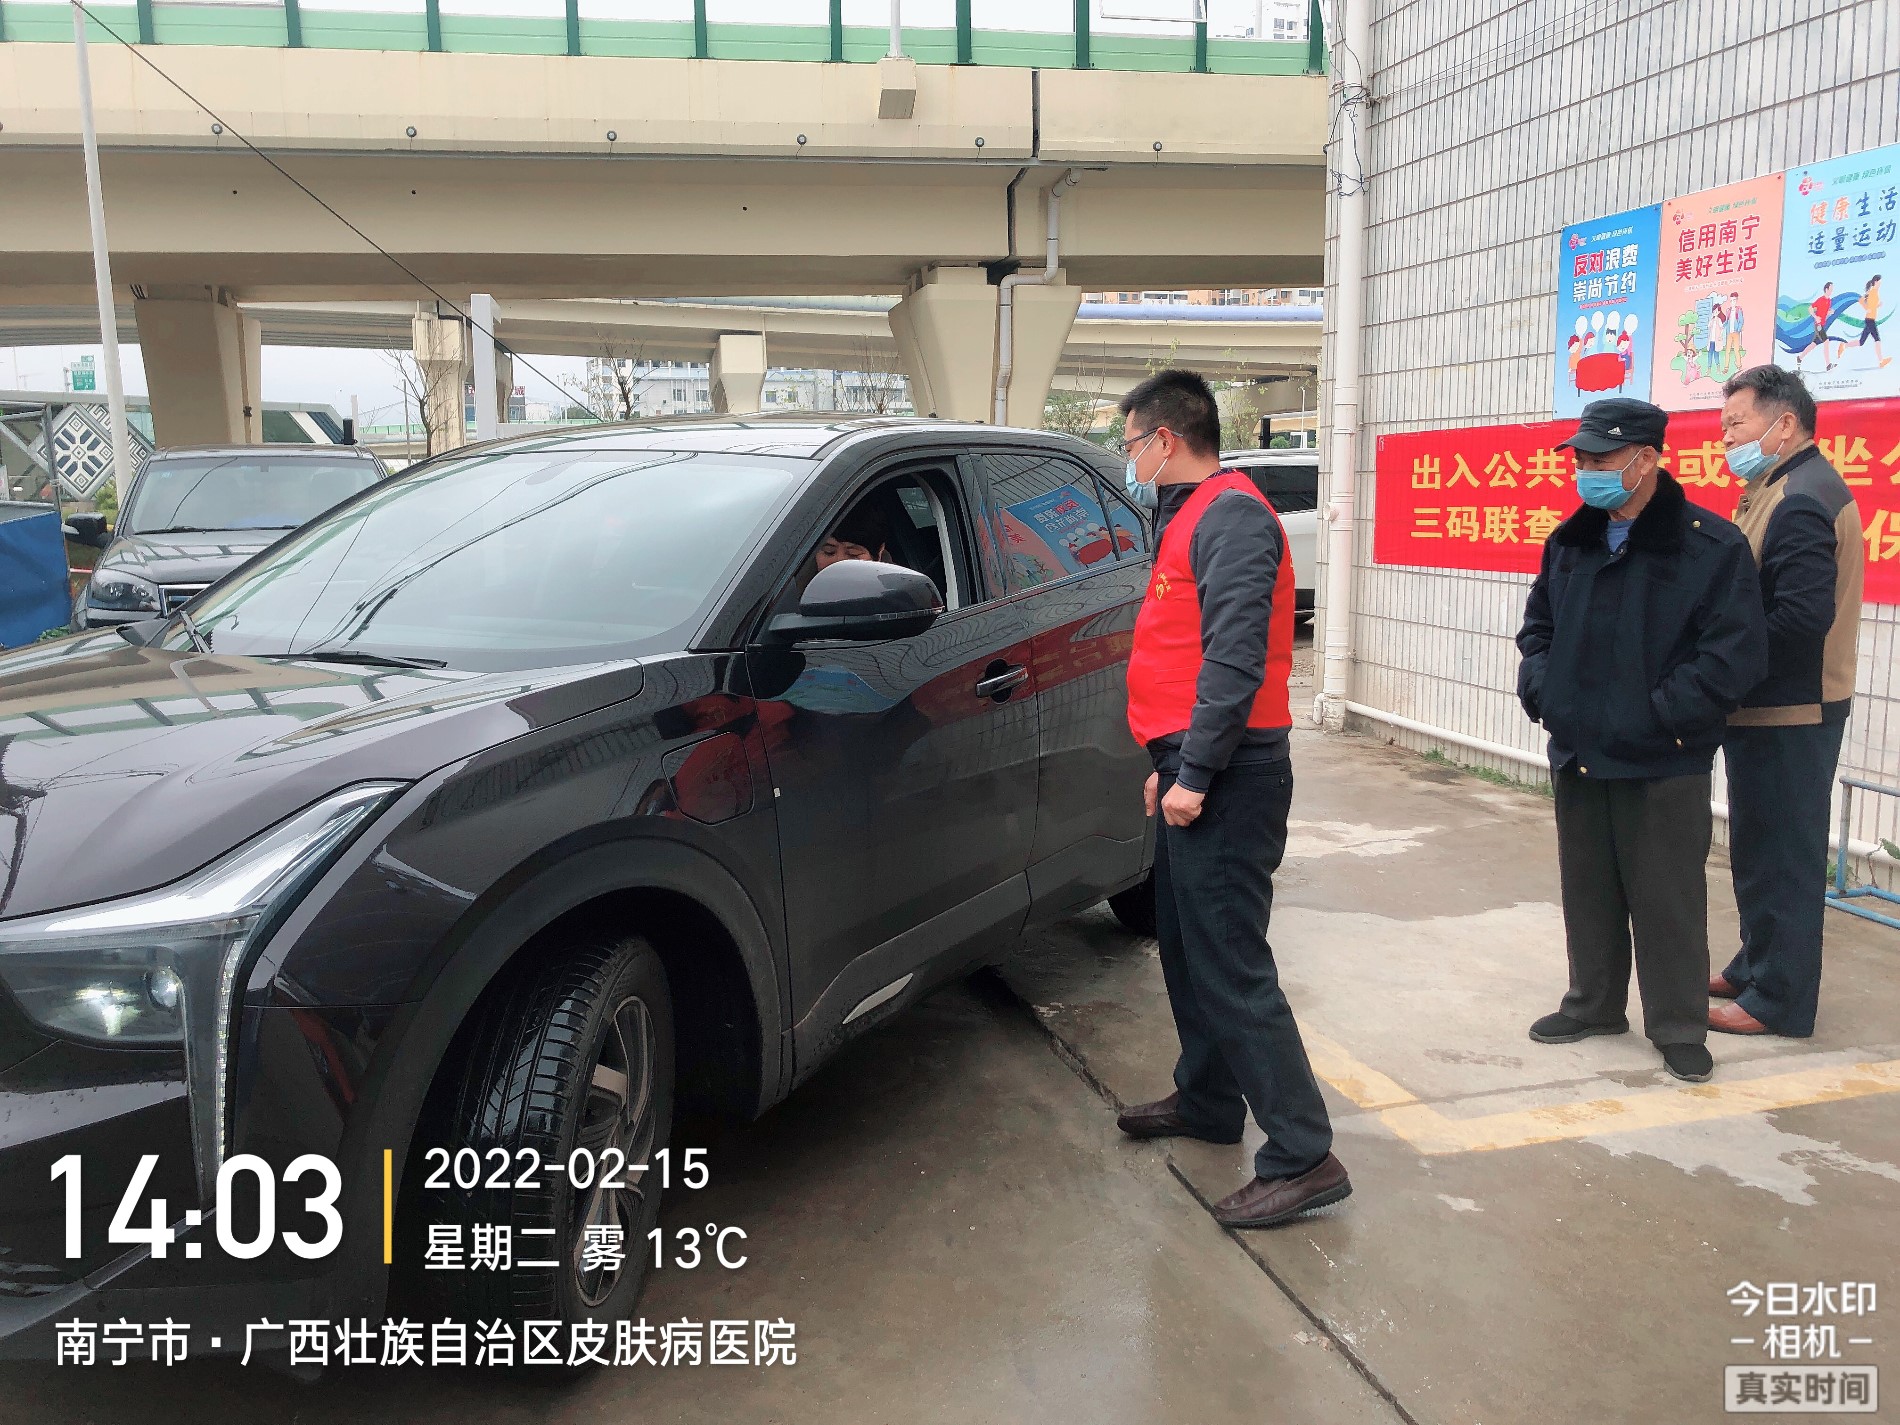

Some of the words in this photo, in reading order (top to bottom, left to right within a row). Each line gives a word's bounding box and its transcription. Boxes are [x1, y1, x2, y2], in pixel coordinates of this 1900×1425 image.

[1810, 185, 1899, 225] 健康生活
[1678, 214, 1760, 254] 信用南宁
[1808, 219, 1897, 255] 适量运动
[1573, 243, 1639, 278] 反对浪费
[1676, 243, 1759, 283] 美好生活
[1572, 271, 1637, 303] 崇尚节约
